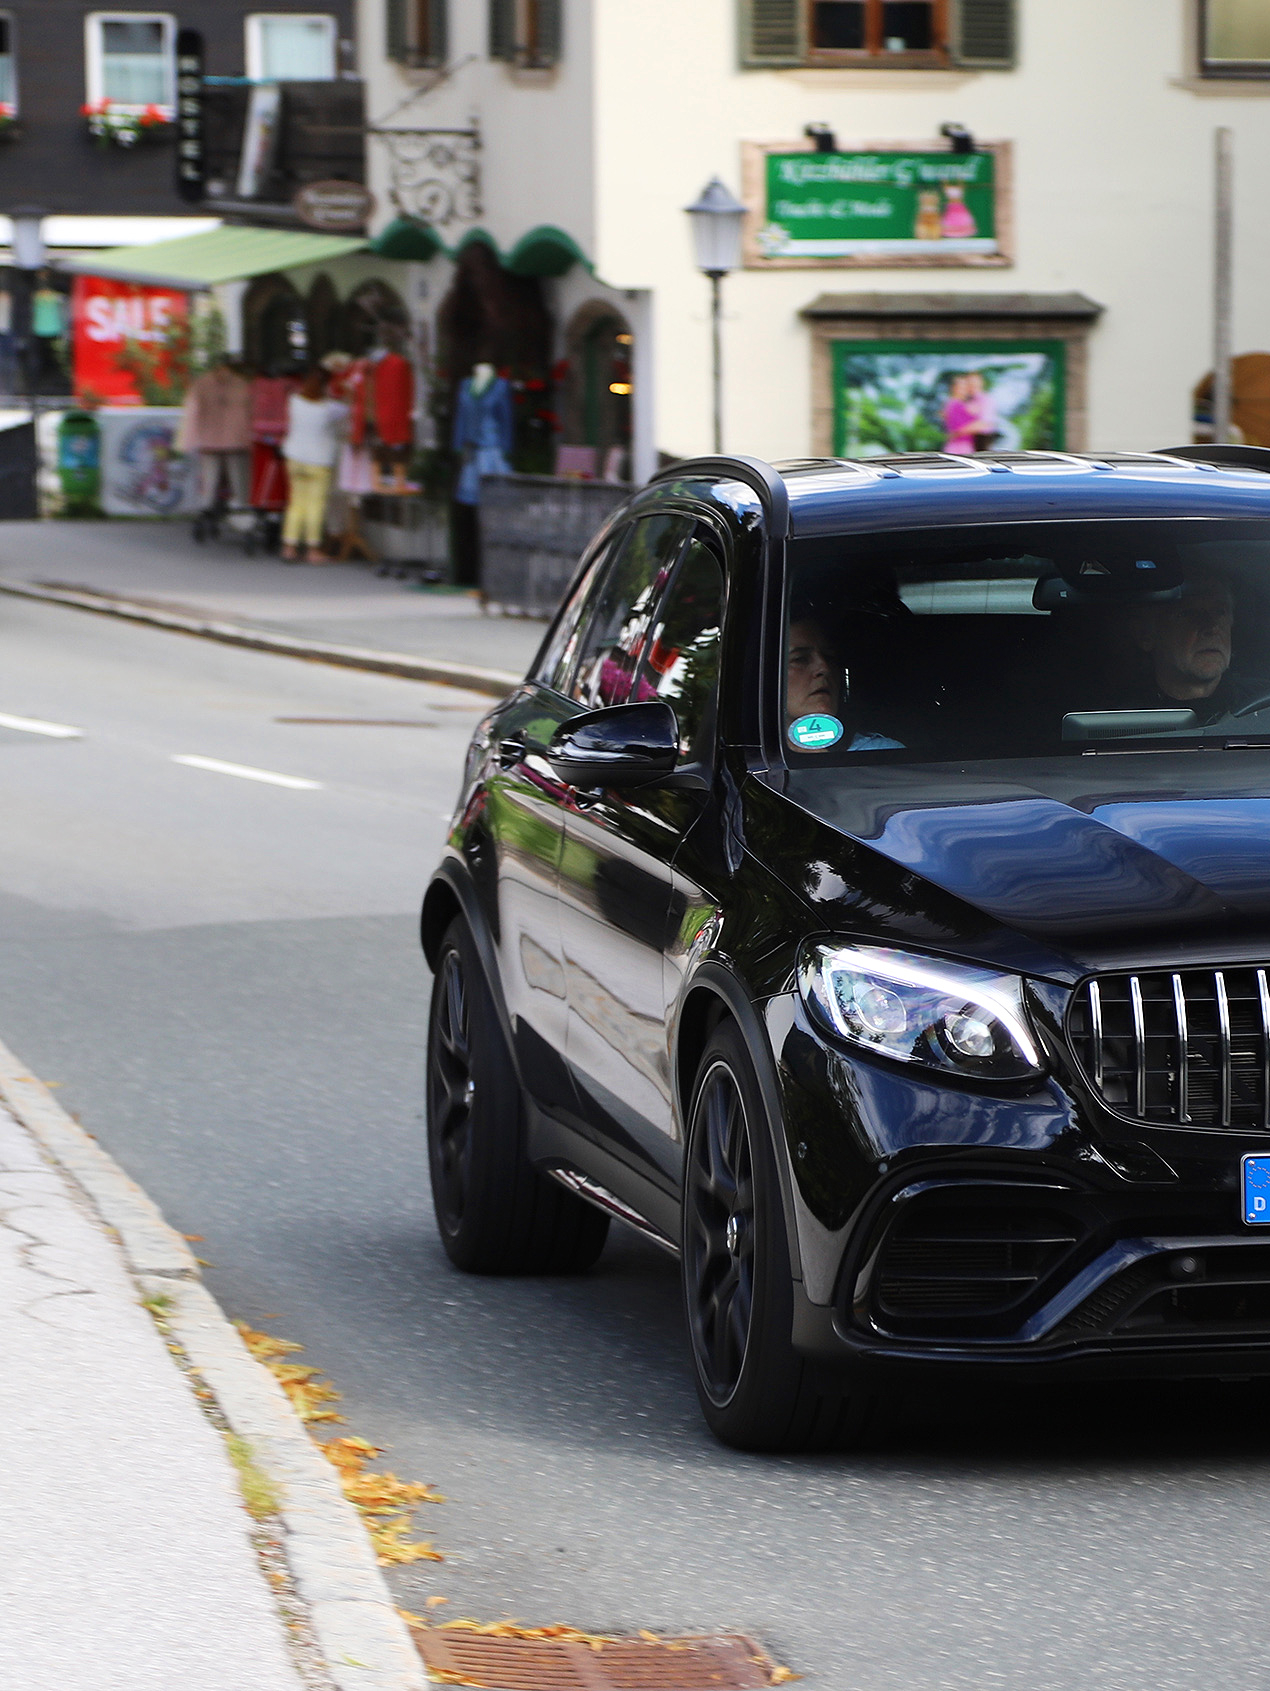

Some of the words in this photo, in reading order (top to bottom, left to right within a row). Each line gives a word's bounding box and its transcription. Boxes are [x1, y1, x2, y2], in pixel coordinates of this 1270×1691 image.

[86, 296, 170, 342] SALE
[809, 719, 822, 731] 4
[1253, 1197, 1266, 1211] D
